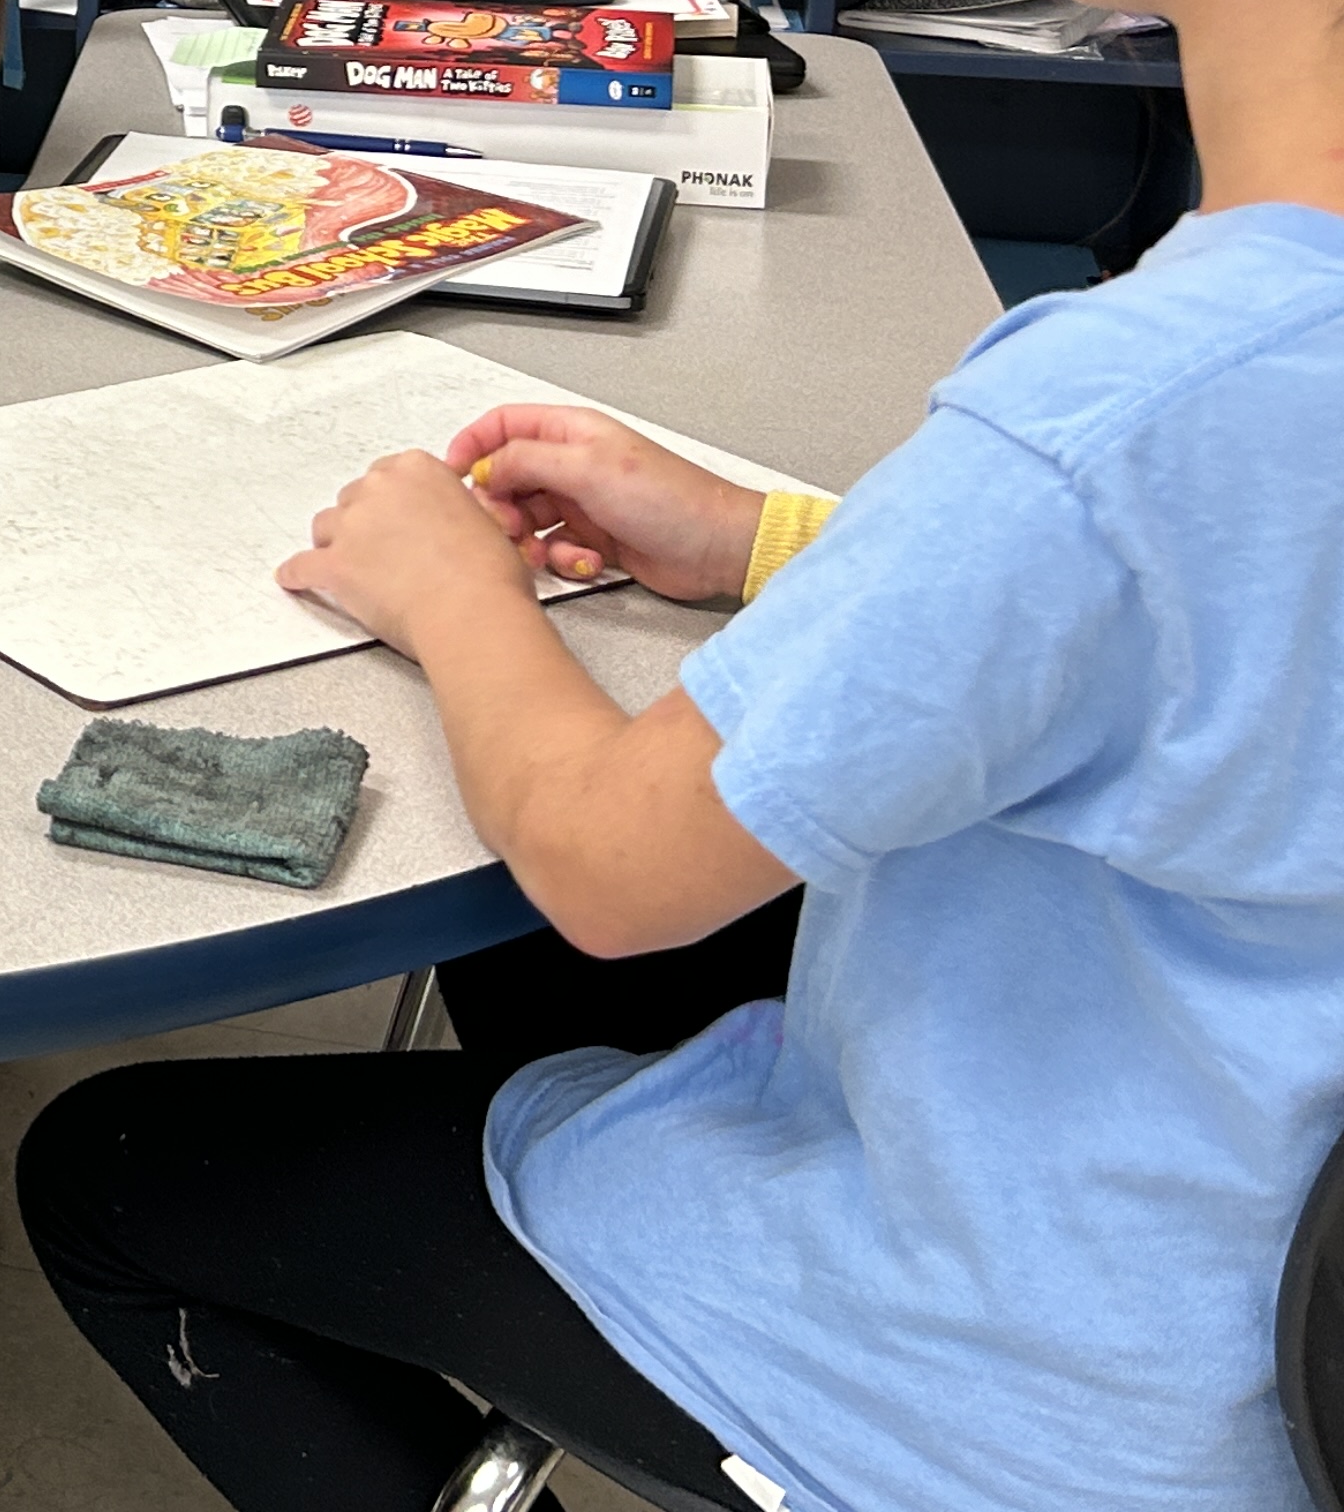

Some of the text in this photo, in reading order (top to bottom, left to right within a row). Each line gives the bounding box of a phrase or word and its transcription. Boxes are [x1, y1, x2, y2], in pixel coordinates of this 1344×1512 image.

[296, 0, 367, 46] DOG MAN
[346, 61, 392, 88] DOG
[394, 66, 438, 89] MAN
[441, 79, 467, 91] Two
[443, 68, 453, 79] A
[681, 170, 753, 187] PHONAK
[405, 207, 528, 247] Magic
[293, 239, 434, 280] School
[219, 270, 317, 296] Bus
